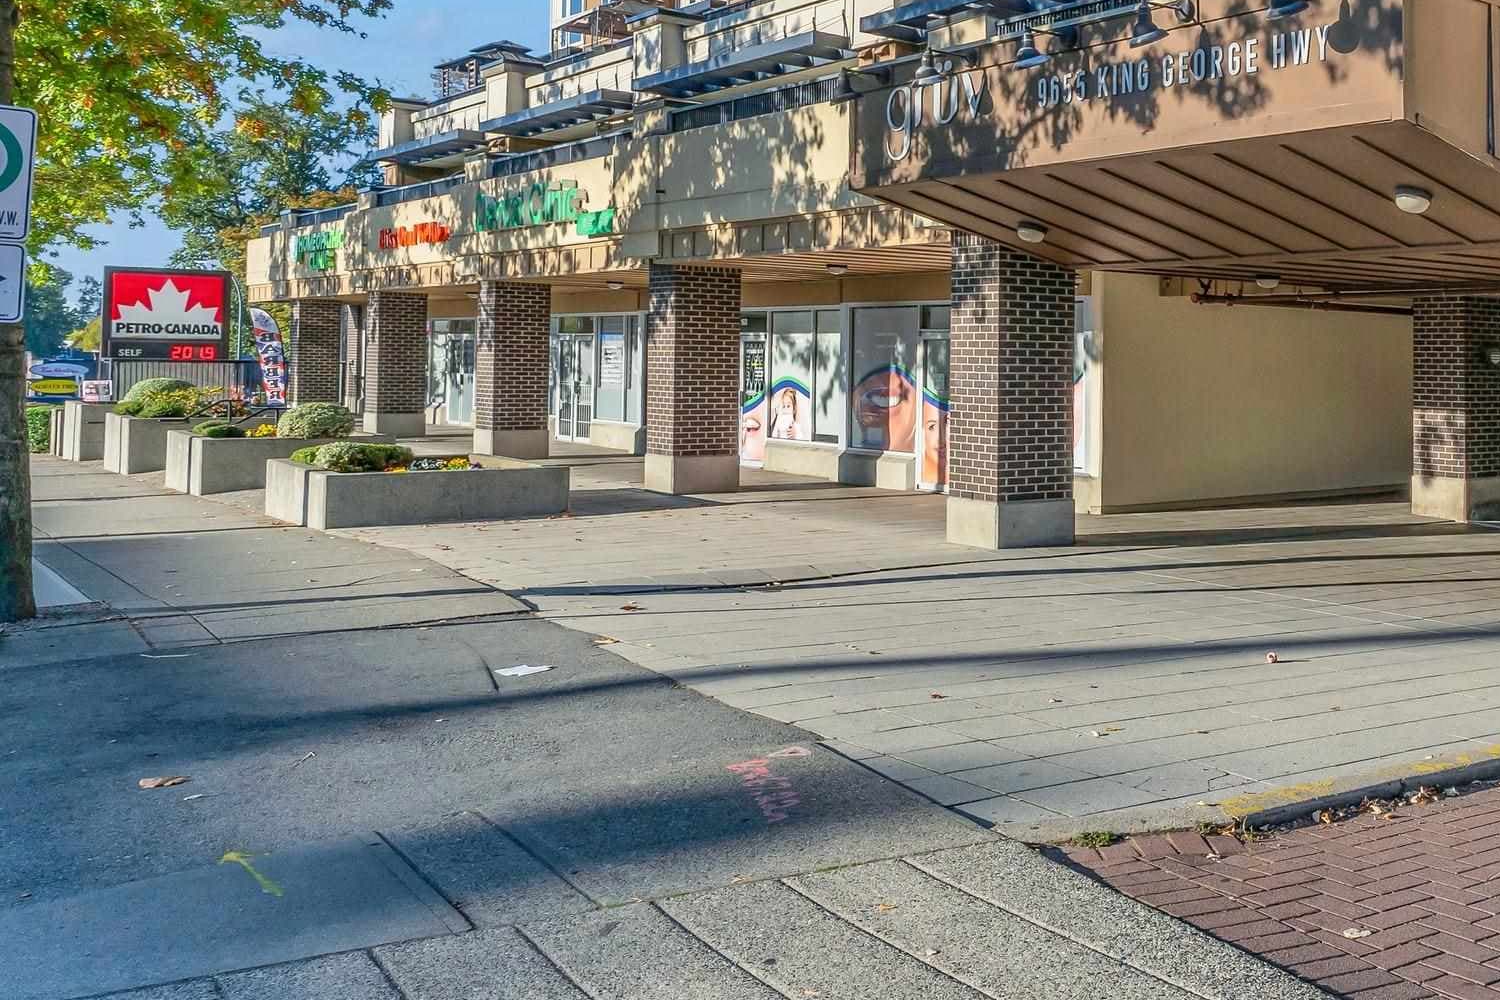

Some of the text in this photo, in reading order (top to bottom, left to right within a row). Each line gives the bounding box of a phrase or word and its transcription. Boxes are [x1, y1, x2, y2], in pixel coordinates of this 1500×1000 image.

[1037, 24, 1330, 108] 9655 KING GEORGE HWY
[116, 322, 220, 335] PETRO-CANADA
[118, 349, 143, 357] SELF
